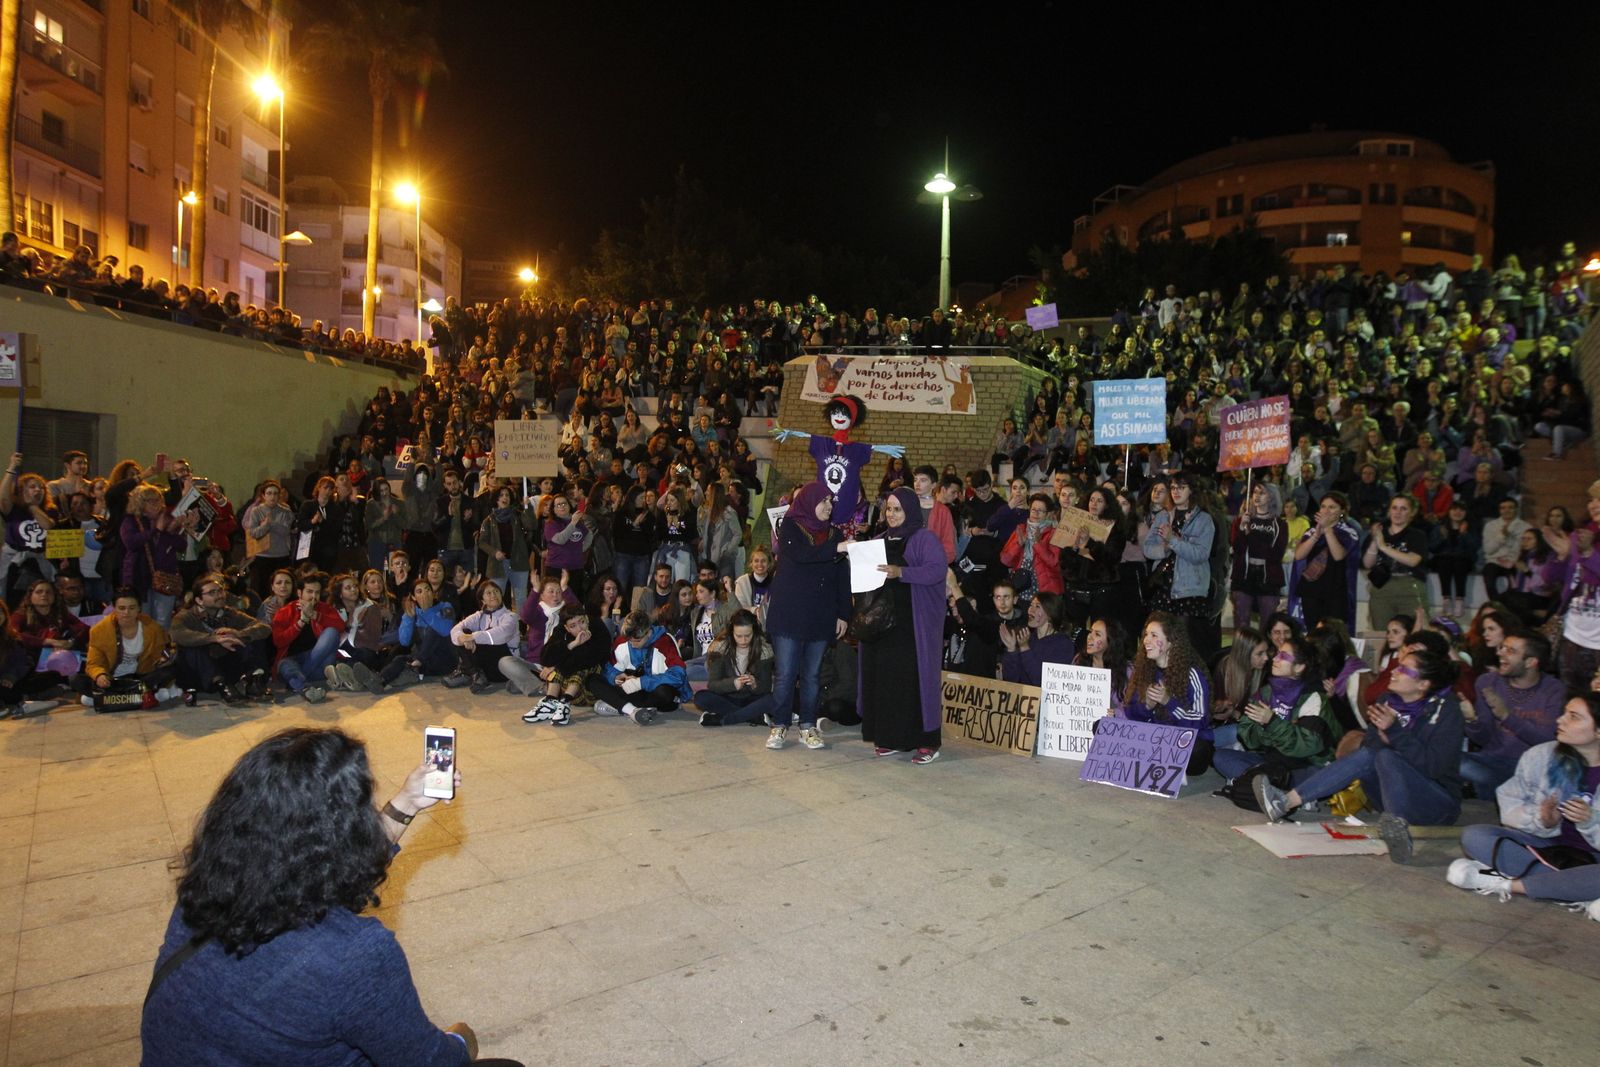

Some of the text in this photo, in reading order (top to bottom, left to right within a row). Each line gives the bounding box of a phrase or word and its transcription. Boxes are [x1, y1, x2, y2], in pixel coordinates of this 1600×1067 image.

[855, 366, 937, 380] vamos unidas
[847, 378, 943, 392] por los derechos
[864, 390, 879, 401] de
[882, 391, 916, 402] todas
[1111, 411, 1152, 420] QUE MIL
[1260, 403, 1273, 419] NO
[1273, 401, 1285, 416] SE
[512, 421, 546, 432] LIBRES
[1100, 422, 1164, 439] ASESINADAS
[1246, 427, 1260, 441] NO
[1251, 435, 1289, 454] CADENAS
[1076, 670, 1087, 681] NO
[1089, 673, 1108, 682] TENER
[1046, 680, 1102, 694] QUE MIRAR PARA
[103, 694, 142, 704] MOSCHIN
[998, 690, 1039, 719] PLACE
[1044, 692, 1103, 708] ATRÁS AL ABRIR
[1056, 705, 1097, 718] EL PORTAL
[945, 706, 1036, 752] THE RESISTANCE
[1069, 718, 1093, 732] TORTÍC
[1043, 733, 1052, 741] EN
[1097, 720, 1138, 740] SOMOS
[1150, 727, 1195, 749] GRITO
[1043, 734, 1092, 753] LA LIBERT
[1107, 742, 1126, 758] LAS
[1147, 745, 1162, 764] YA
[1165, 748, 1189, 765] NO
